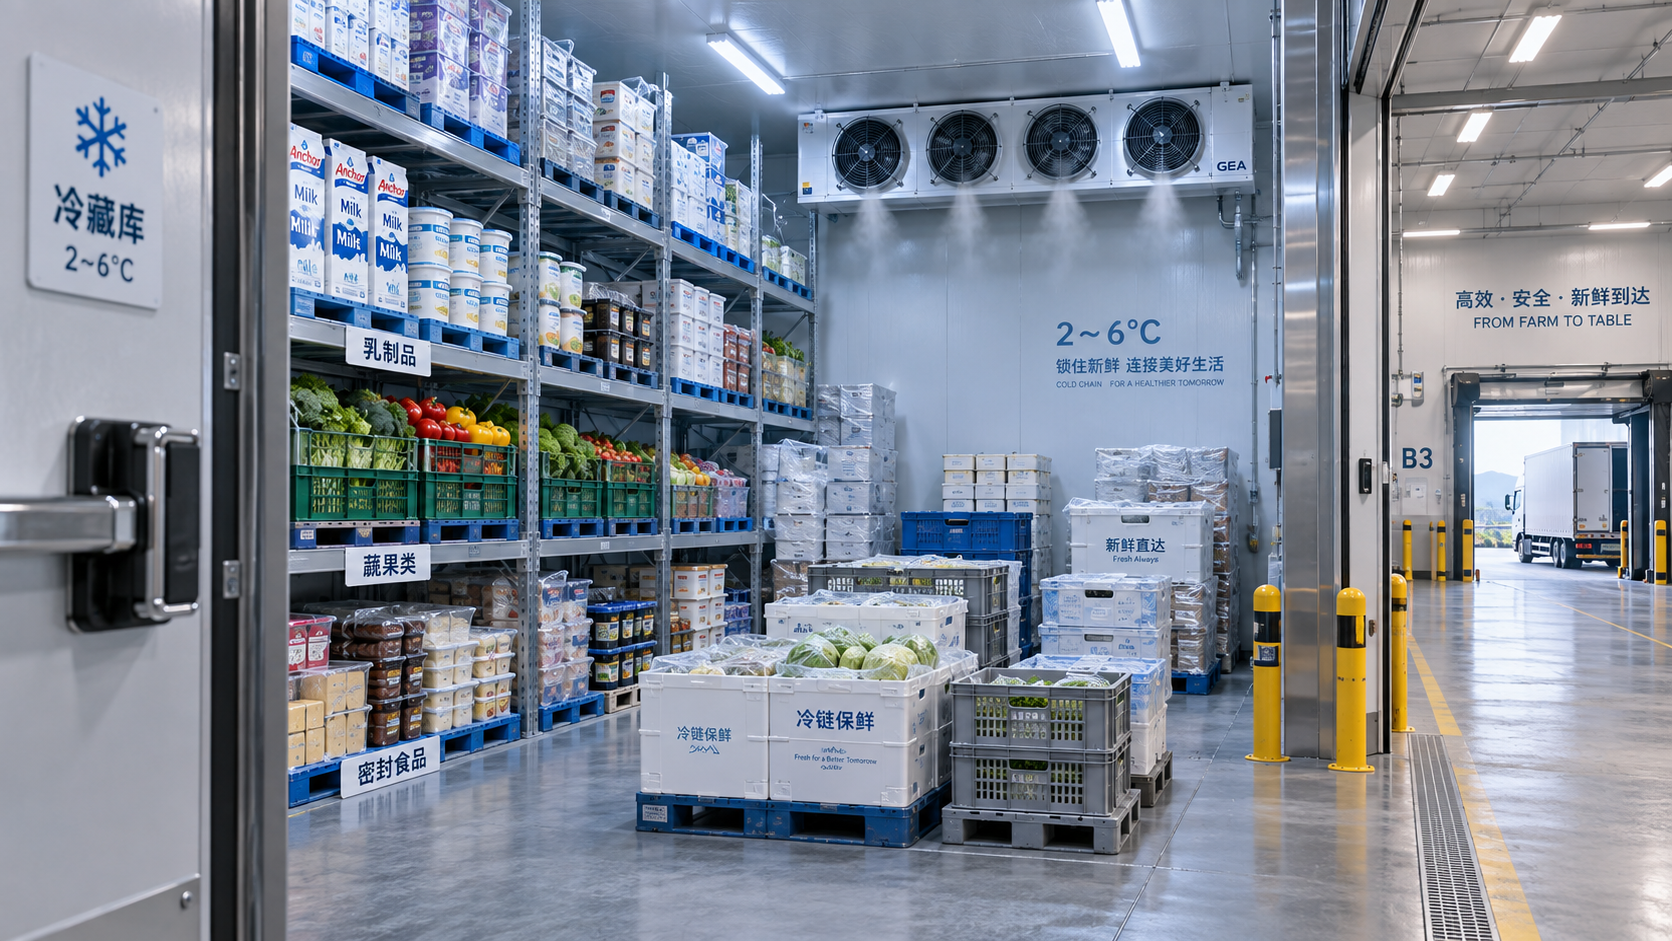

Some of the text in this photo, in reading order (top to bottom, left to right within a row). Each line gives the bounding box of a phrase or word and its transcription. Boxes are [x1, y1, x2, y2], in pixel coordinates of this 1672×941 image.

[1216, 160, 1247, 171] GEA
[53, 184, 145, 245] 冷藏库
[340, 198, 362, 218] Milk
[383, 213, 403, 232] Milk
[1473, 313, 1632, 329] FROM FARM TO TABLE
[363, 337, 416, 367] 乳制品
[1056, 356, 1225, 374] 锁住新鲜 连接美好生活
[1056, 378, 1225, 388] COLD CHAIN FOR A HEALTHIER TOMORROW
[1402, 447, 1433, 469] B3
[1105, 537, 1166, 553] 新鲜直达
[363, 552, 416, 577] 蔬果类
[1112, 555, 1160, 565] Fresh Always
[796, 709, 875, 732] 冷链保鲜
[358, 746, 427, 786] 密封食品
[794, 753, 811, 762] Fresh
[811, 754, 821, 762] for
